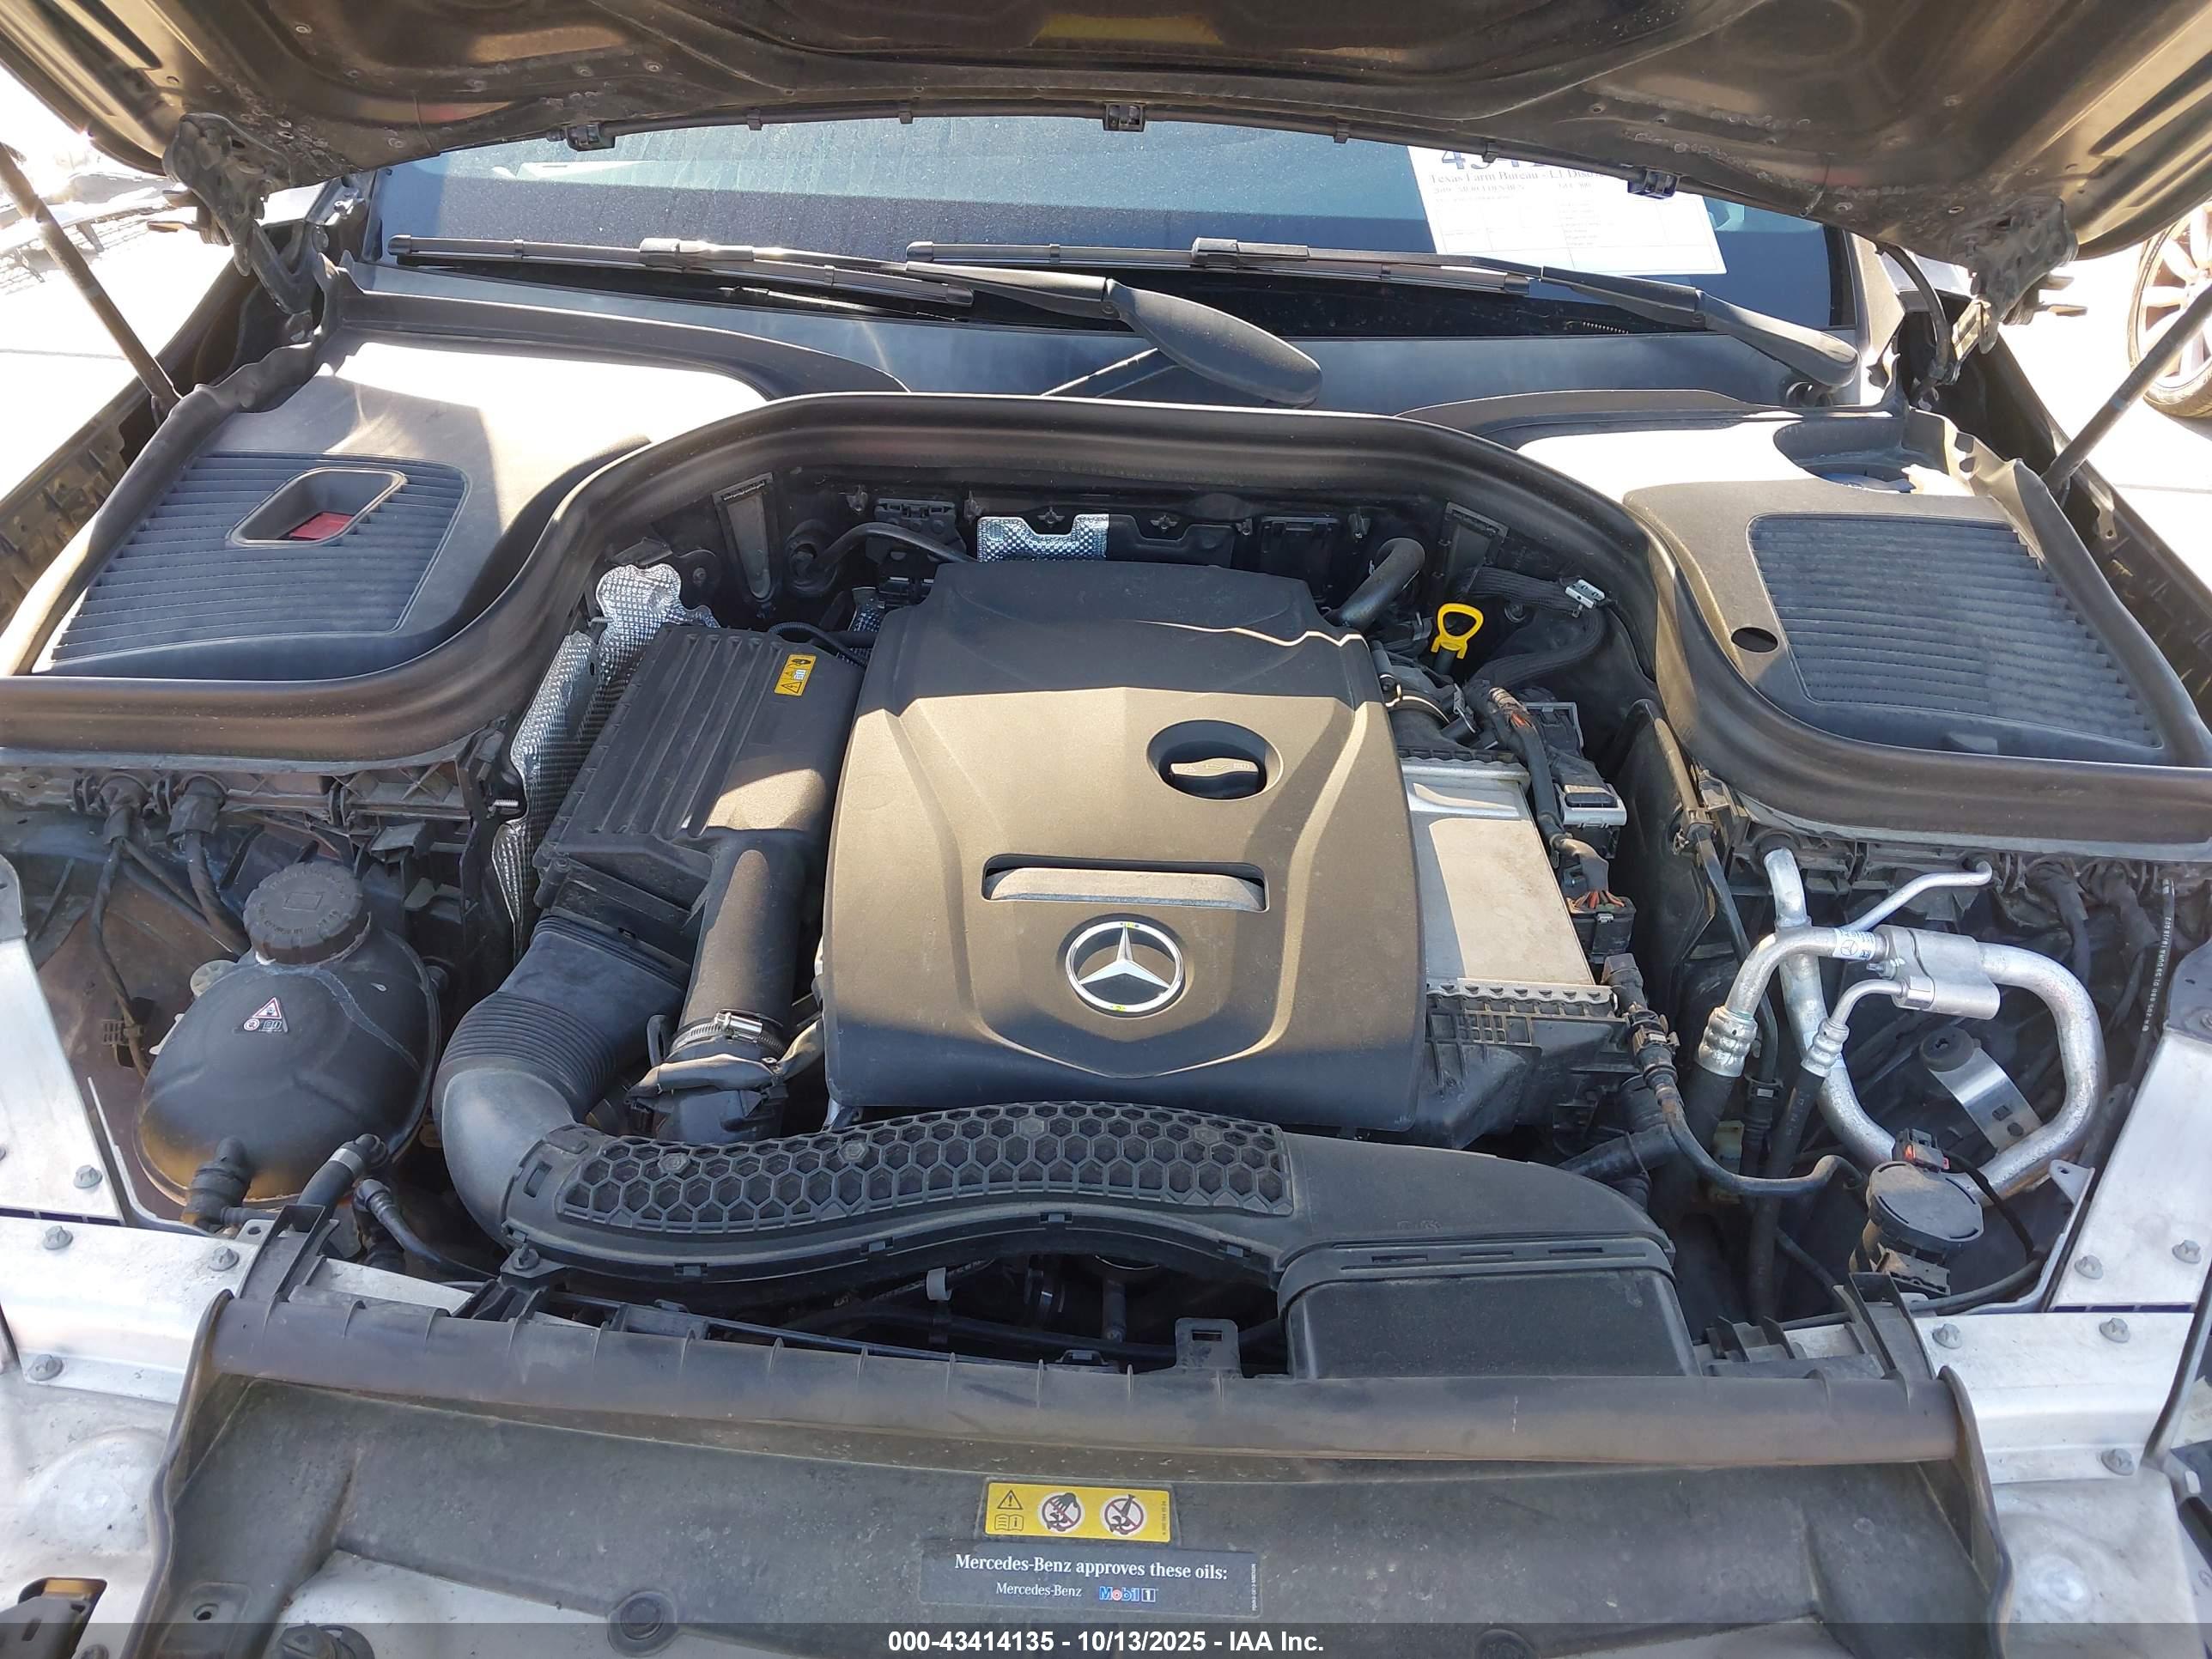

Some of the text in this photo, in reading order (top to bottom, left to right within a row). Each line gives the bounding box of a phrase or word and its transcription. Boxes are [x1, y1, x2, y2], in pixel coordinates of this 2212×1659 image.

[954, 1553, 1228, 1580] Mercedes-Benz approves these oils:
[995, 1582, 1083, 1597] Mercedes-Benz
[1098, 1586, 1140, 1601] Mobil
